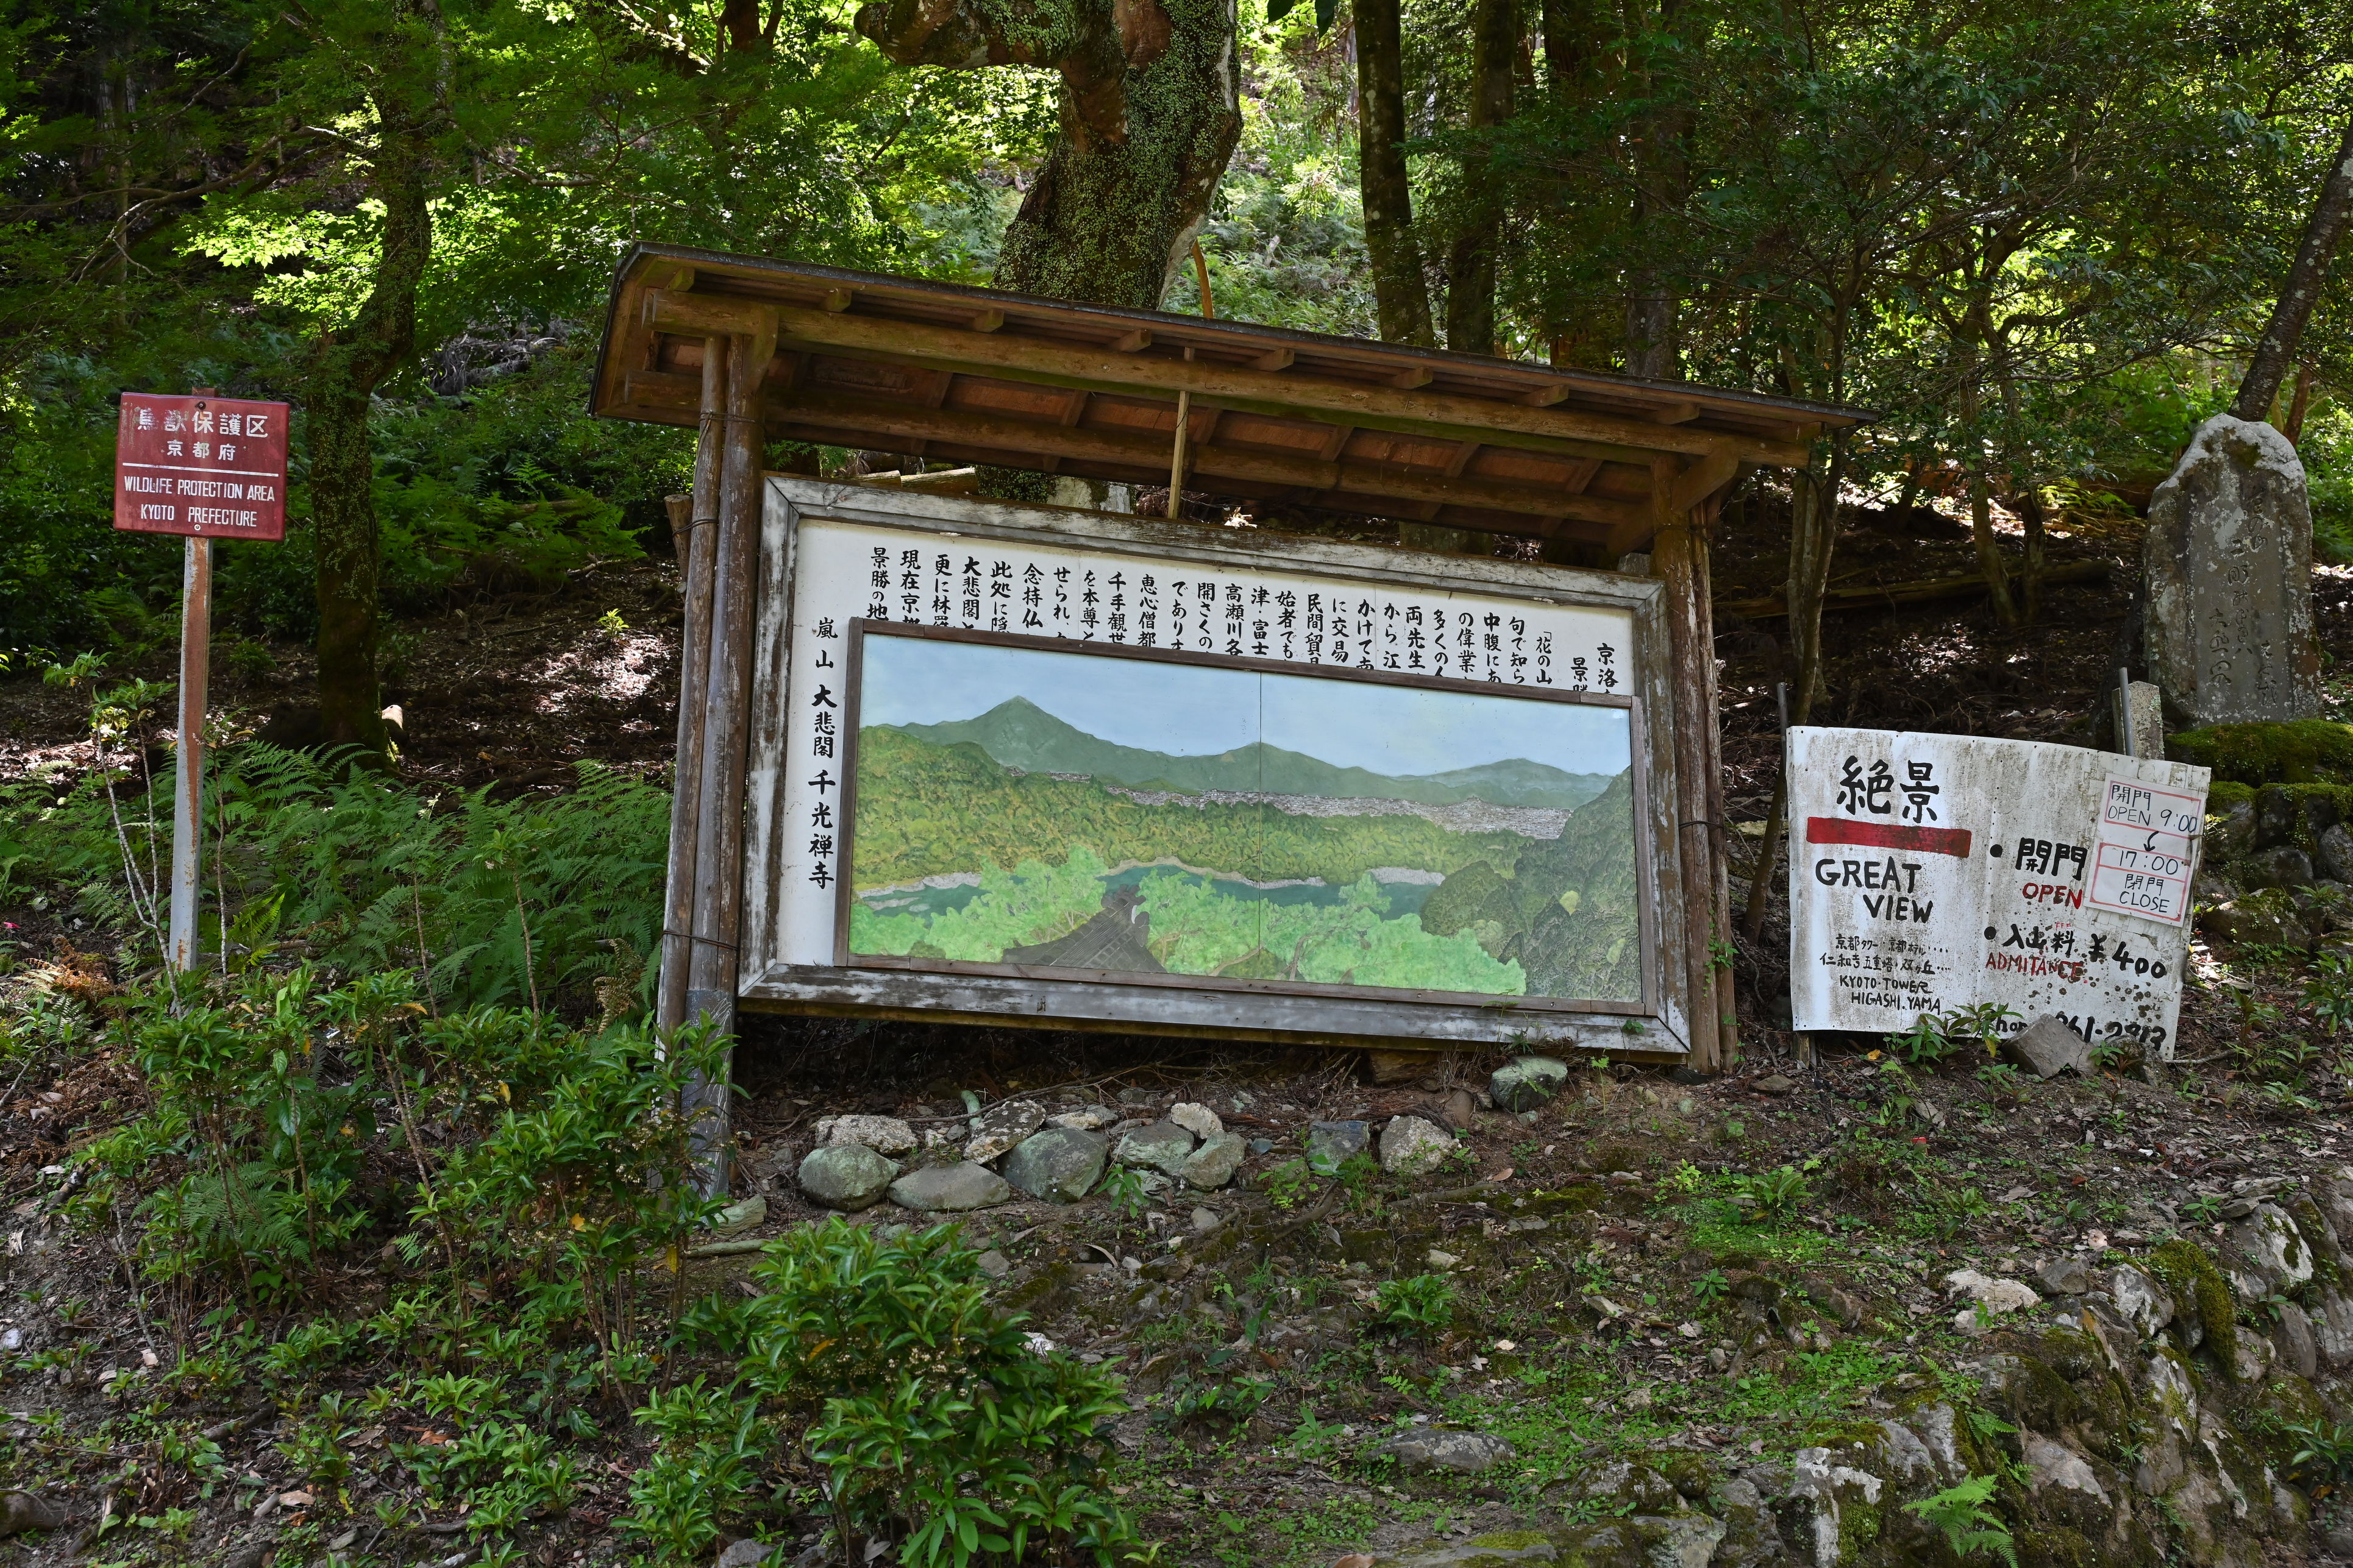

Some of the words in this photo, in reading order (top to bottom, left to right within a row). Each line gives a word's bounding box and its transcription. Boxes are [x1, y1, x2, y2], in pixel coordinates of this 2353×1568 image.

[167, 439, 236, 461] 京都府
[124, 475, 173, 494] WILDLIFE
[177, 479, 242, 499] PROTECTION
[247, 484, 275, 502] AREA
[141, 504, 174, 520] KYOTO
[188, 506, 257, 527] PREFECTURE
[866, 547, 890, 621] 景勝の地
[1022, 563, 1045, 635] 念持仏
[1108, 572, 1127, 644] 千手観世
[1137, 573, 1159, 647] 恵心僧都
[1197, 582, 1215, 653] 開さくの
[1225, 583, 1244, 656] 高瀬川各
[1251, 586, 1270, 655] 津・富士
[1275, 591, 1297, 661] 始者でも
[1331, 598, 1350, 663] に交易
[1383, 603, 1401, 669] から江
[1406, 606, 1426, 675] 両先生
[1456, 612, 1476, 679] の偉業
[1484, 612, 1502, 683] 中腹にあ
[1508, 616, 1528, 684] 句で知ら
[1597, 642, 1619, 694] 京洛
[1836, 755, 1940, 823] 絶景
[2108, 806, 2151, 826] OPEN
[2160, 809, 2198, 832] 9:00
[2111, 784, 2151, 811] 開門
[1815, 856, 1922, 893] GREAT
[2016, 837, 2088, 881] 開門
[2120, 850, 2178, 874] 17:00
[2125, 874, 2164, 896] 閉門
[1864, 894, 1934, 924] VIEW
[2023, 882, 2082, 909] OPEN
[2120, 891, 2170, 913] CLOSE
[1985, 952, 2084, 979] ADMITANCE
